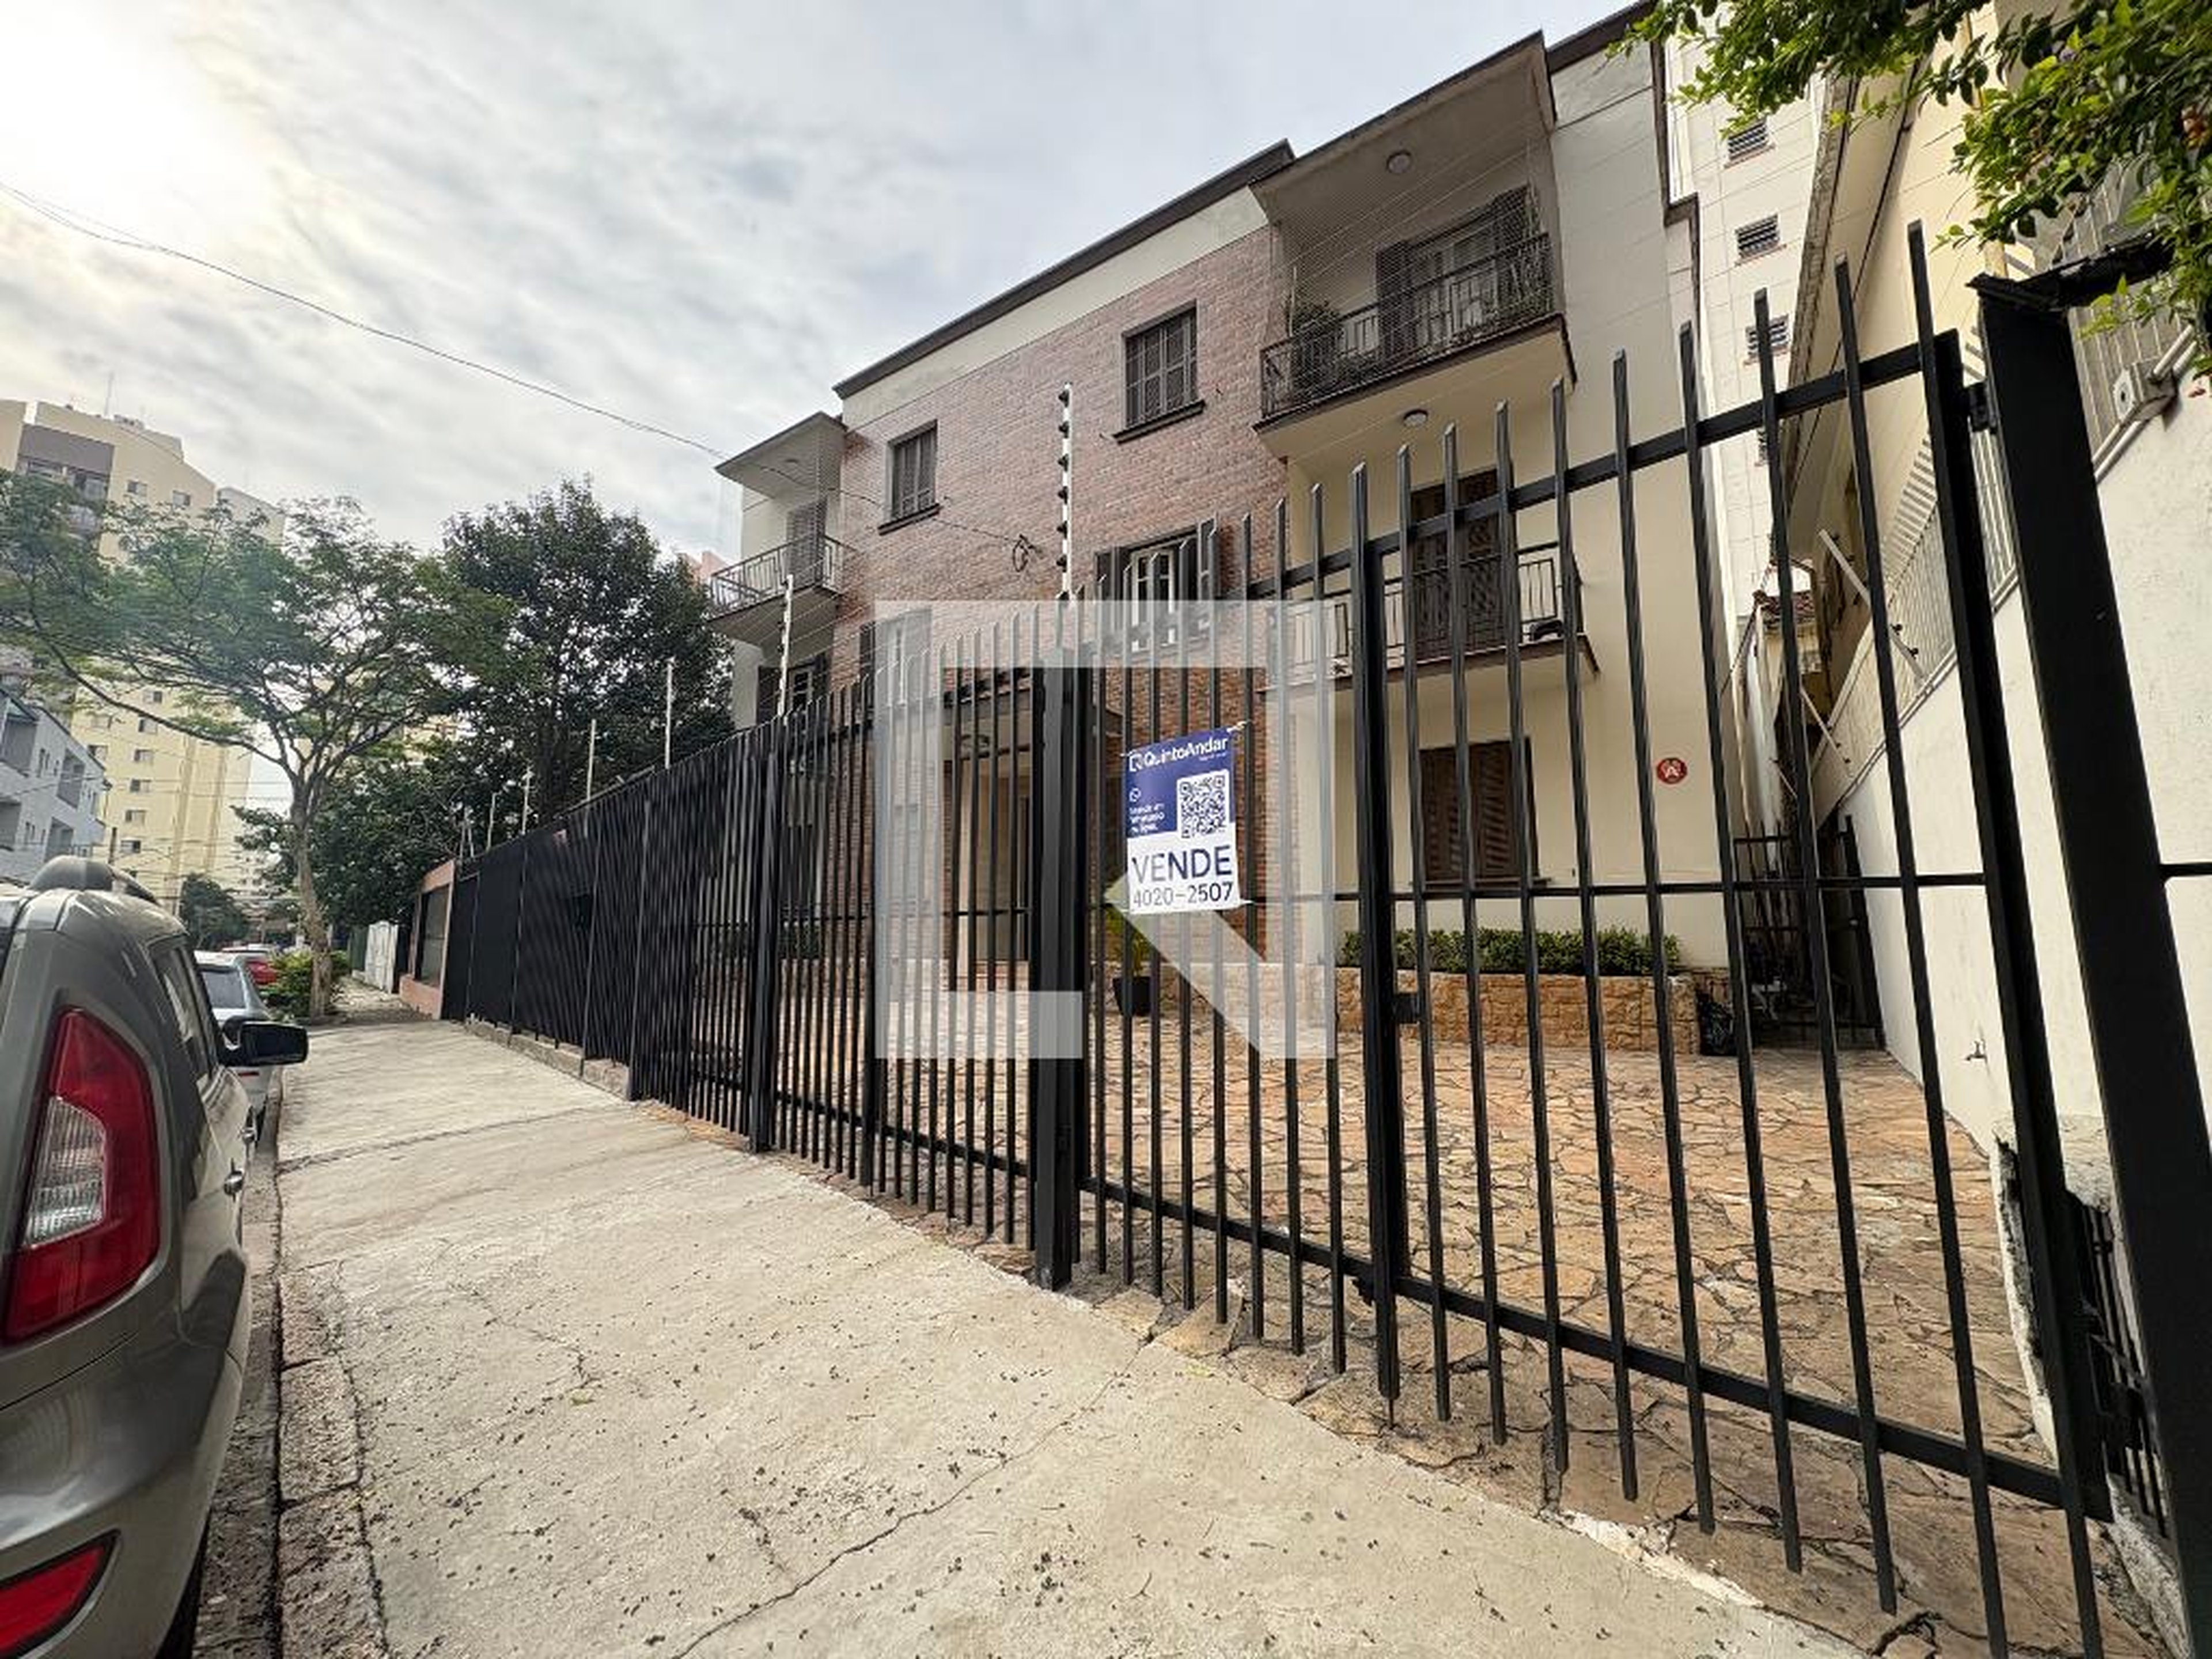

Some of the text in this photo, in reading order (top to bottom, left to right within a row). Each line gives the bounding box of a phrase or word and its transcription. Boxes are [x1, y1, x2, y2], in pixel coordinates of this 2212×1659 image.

[1143, 737, 1228, 767] QuintoAndar
[1131, 844, 1232, 884] VENDE
[1133, 881, 1233, 908] 4020-2507
